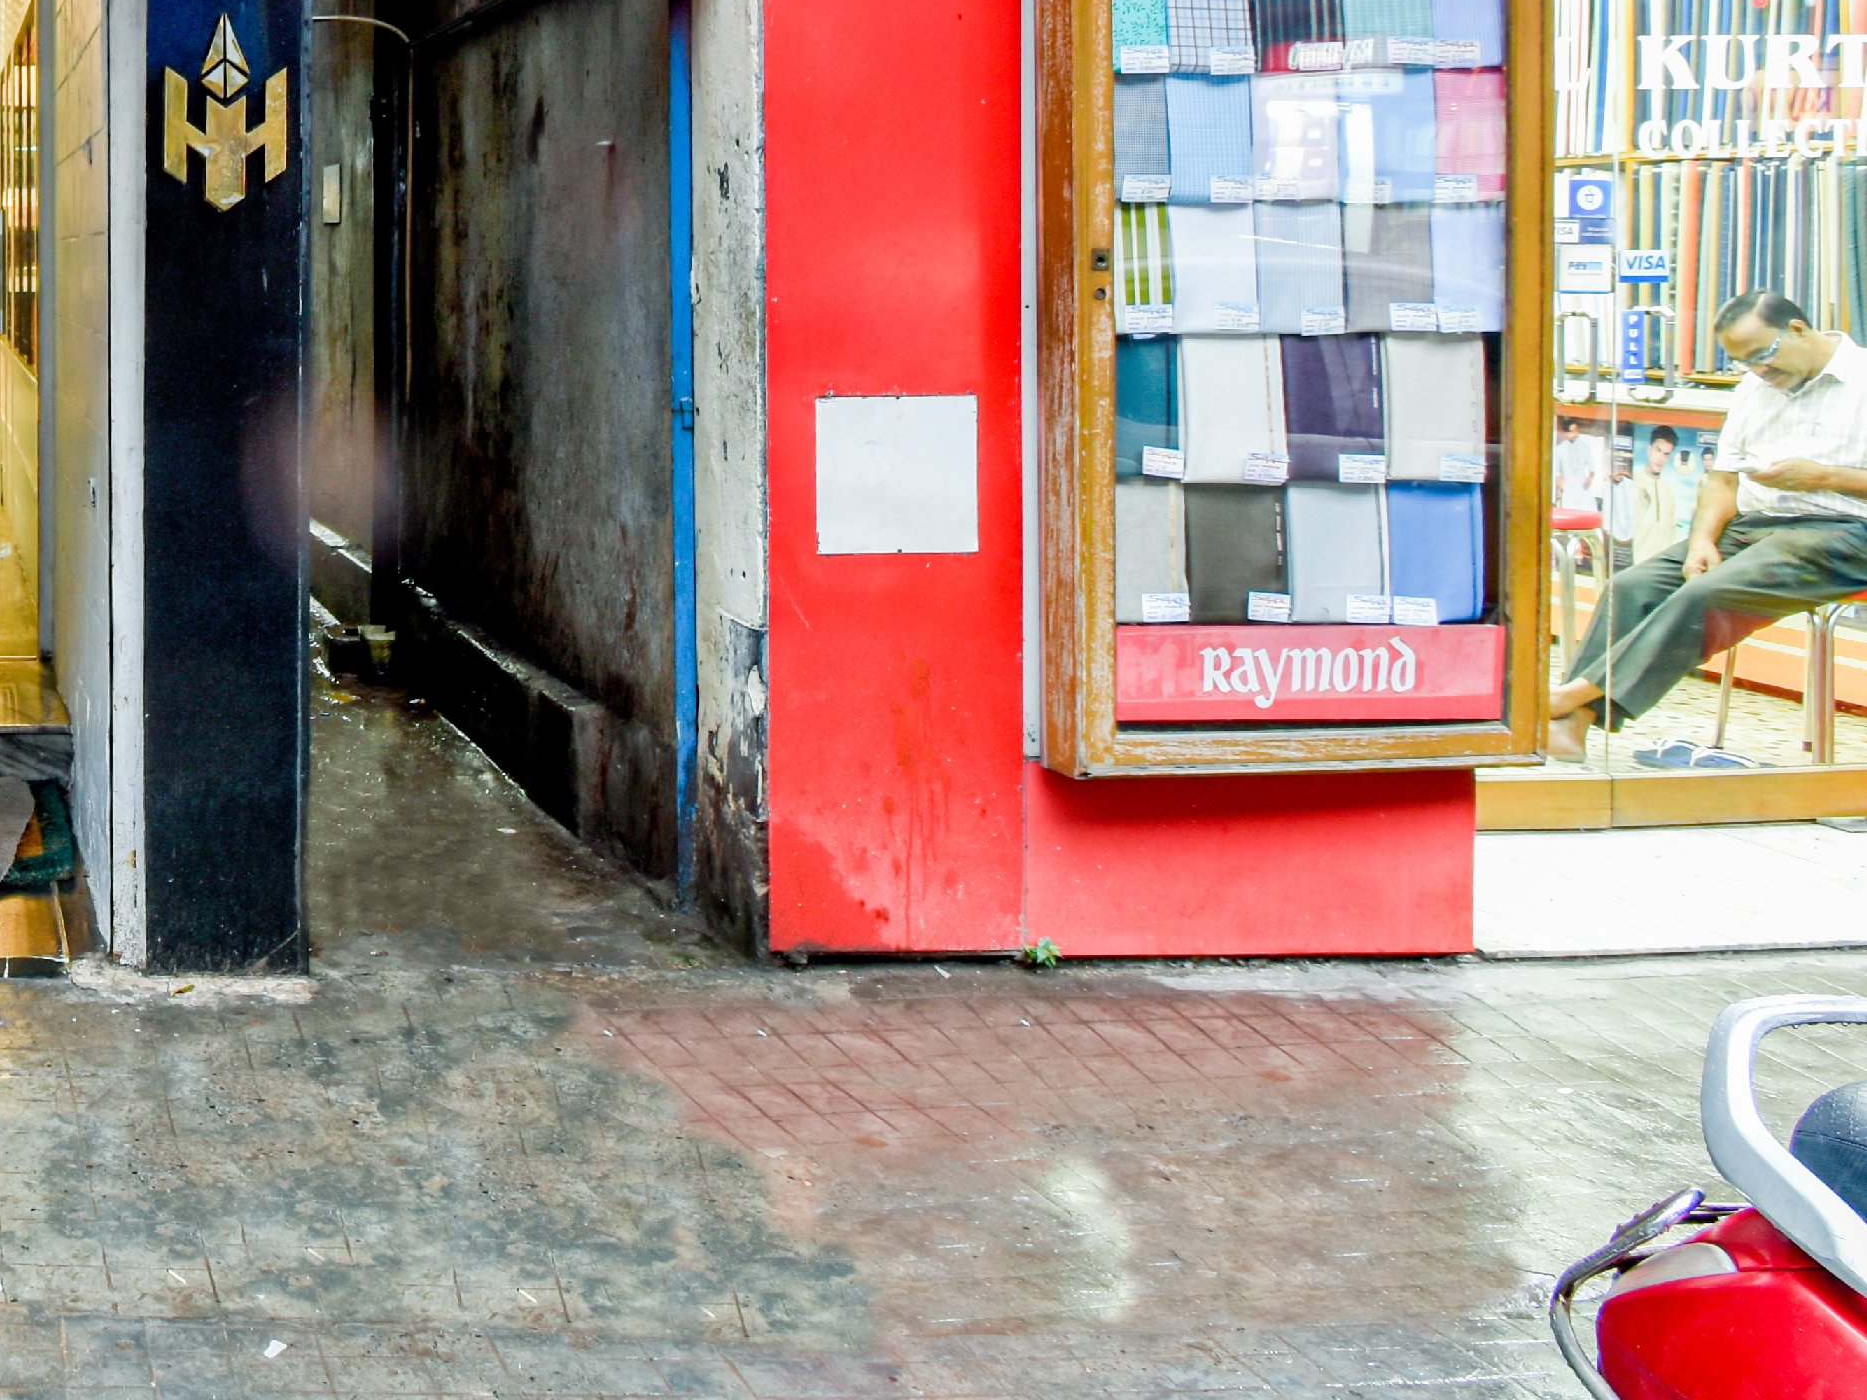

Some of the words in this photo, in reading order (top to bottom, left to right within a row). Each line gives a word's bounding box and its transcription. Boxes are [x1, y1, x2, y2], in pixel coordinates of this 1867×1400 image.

[1637, 34, 1867, 90] KURT
[1626, 255, 1666, 271] VISA
[1629, 314, 1638, 365] PULL
[1199, 636, 1417, 709] Raymond
